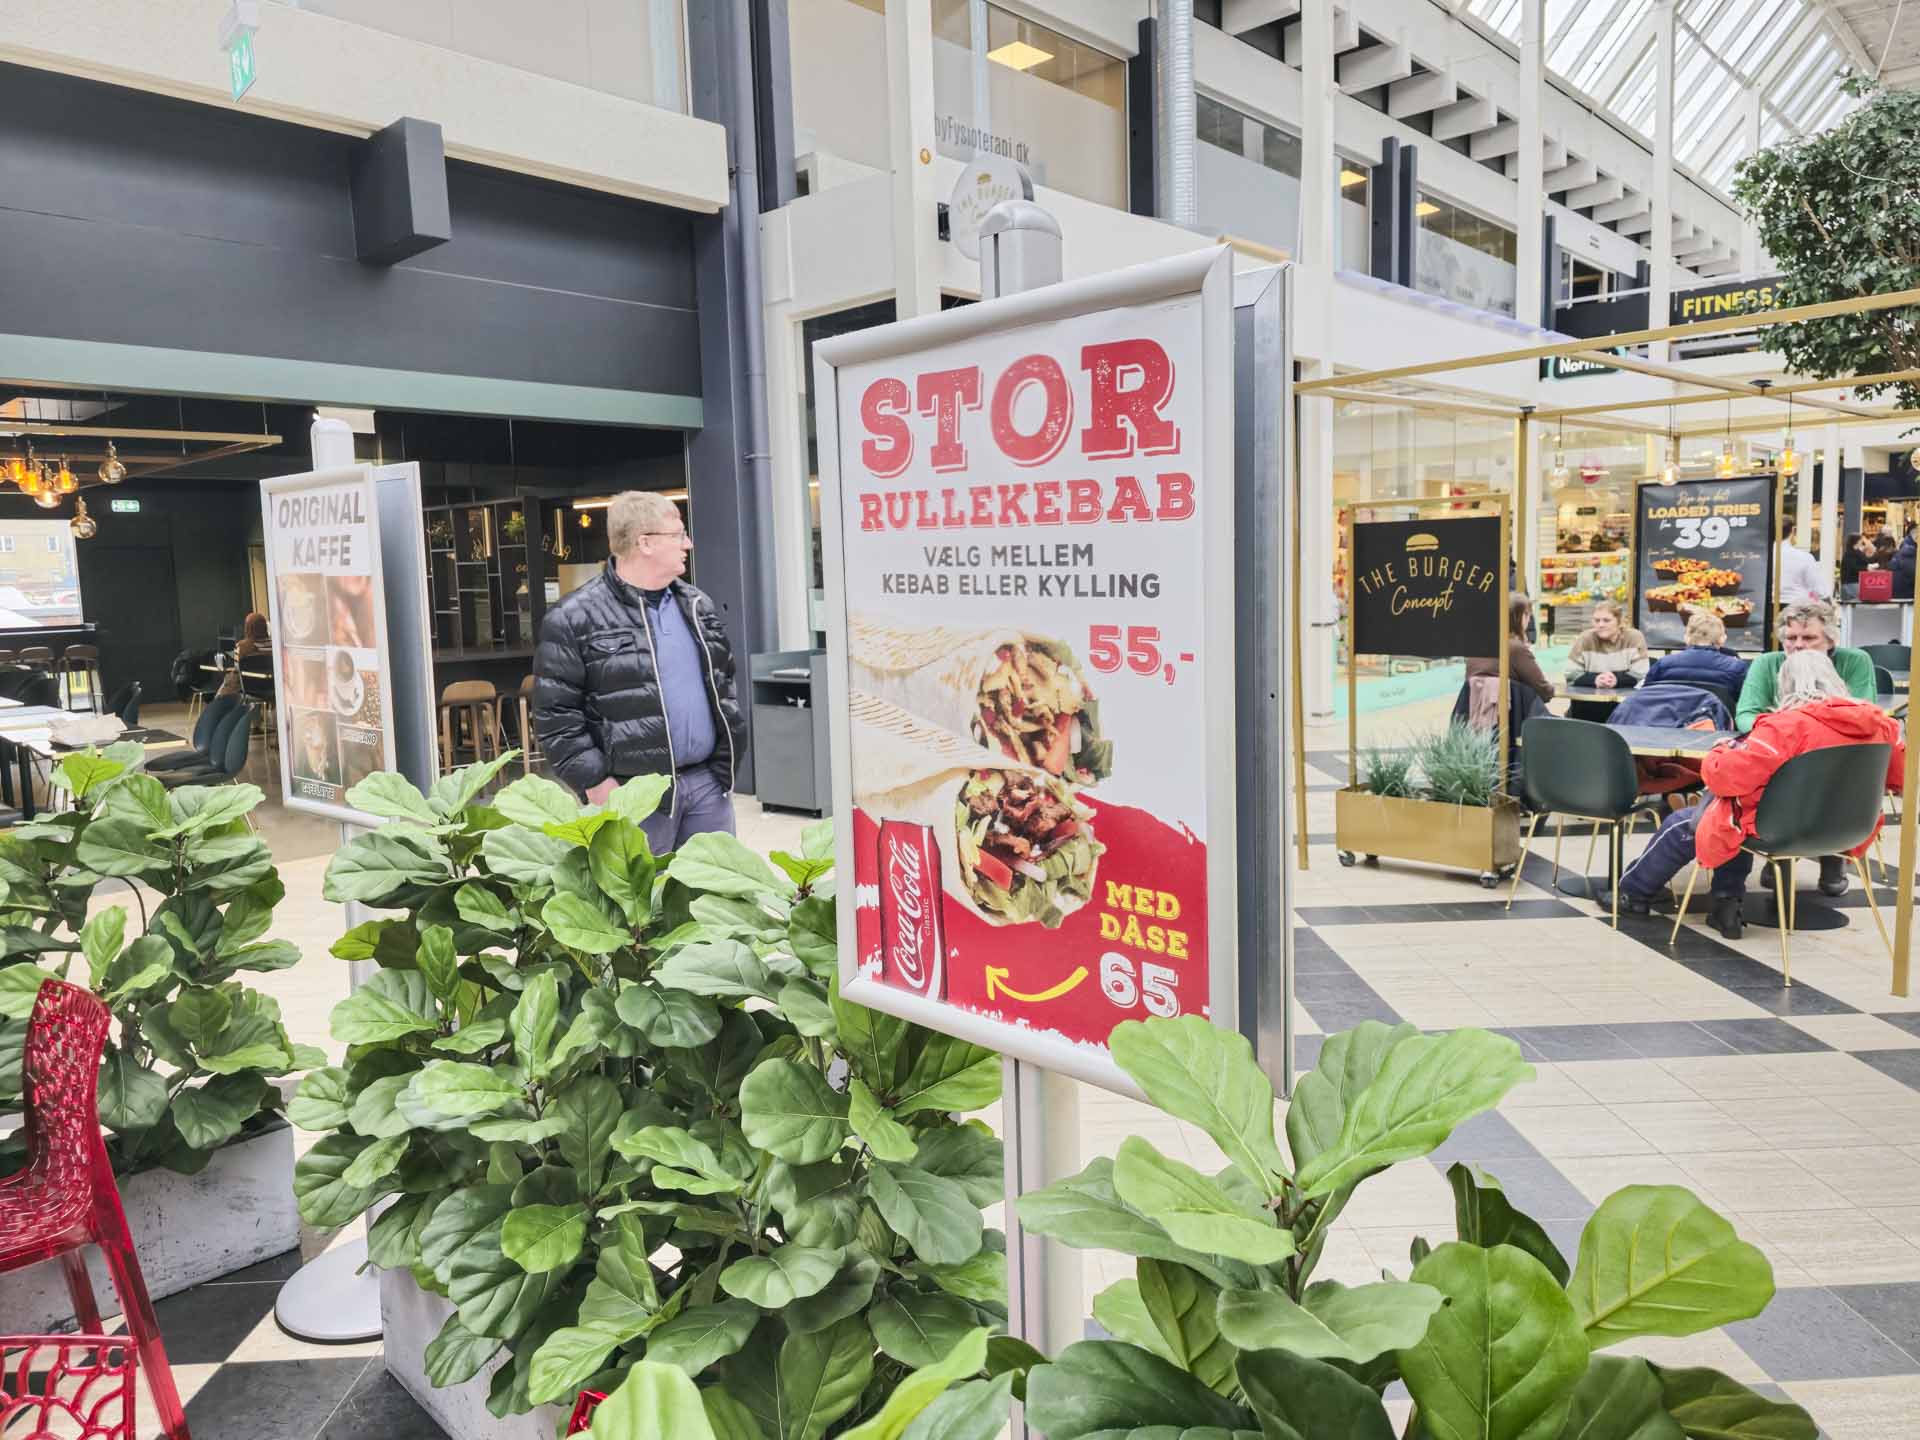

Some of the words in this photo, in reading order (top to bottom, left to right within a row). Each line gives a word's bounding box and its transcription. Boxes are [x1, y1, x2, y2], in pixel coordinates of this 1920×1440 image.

[860, 338, 1181, 479] STOR
[278, 490, 366, 529] ORIGINAL
[860, 472, 1196, 533] RULLEKEBAB
[1647, 504, 1710, 519] LOADED
[1712, 502, 1761, 516] FRIES
[292, 534, 352, 567] KAFFE
[1672, 516, 1731, 549] 39
[924, 546, 981, 567] VÆLG
[991, 543, 1094, 567] MELLEM
[1359, 562, 1398, 594] THE
[1408, 555, 1495, 593] BURGER
[882, 573, 949, 594] KEBAB
[959, 574, 1028, 596] ELLER
[1039, 572, 1161, 598] KYLLING
[1391, 580, 1454, 618] Concept
[1088, 624, 1195, 685] 55,-
[889, 831, 925, 989] Coca-Cola
[1105, 879, 1181, 920] MED
[1099, 912, 1189, 960] DÅSE
